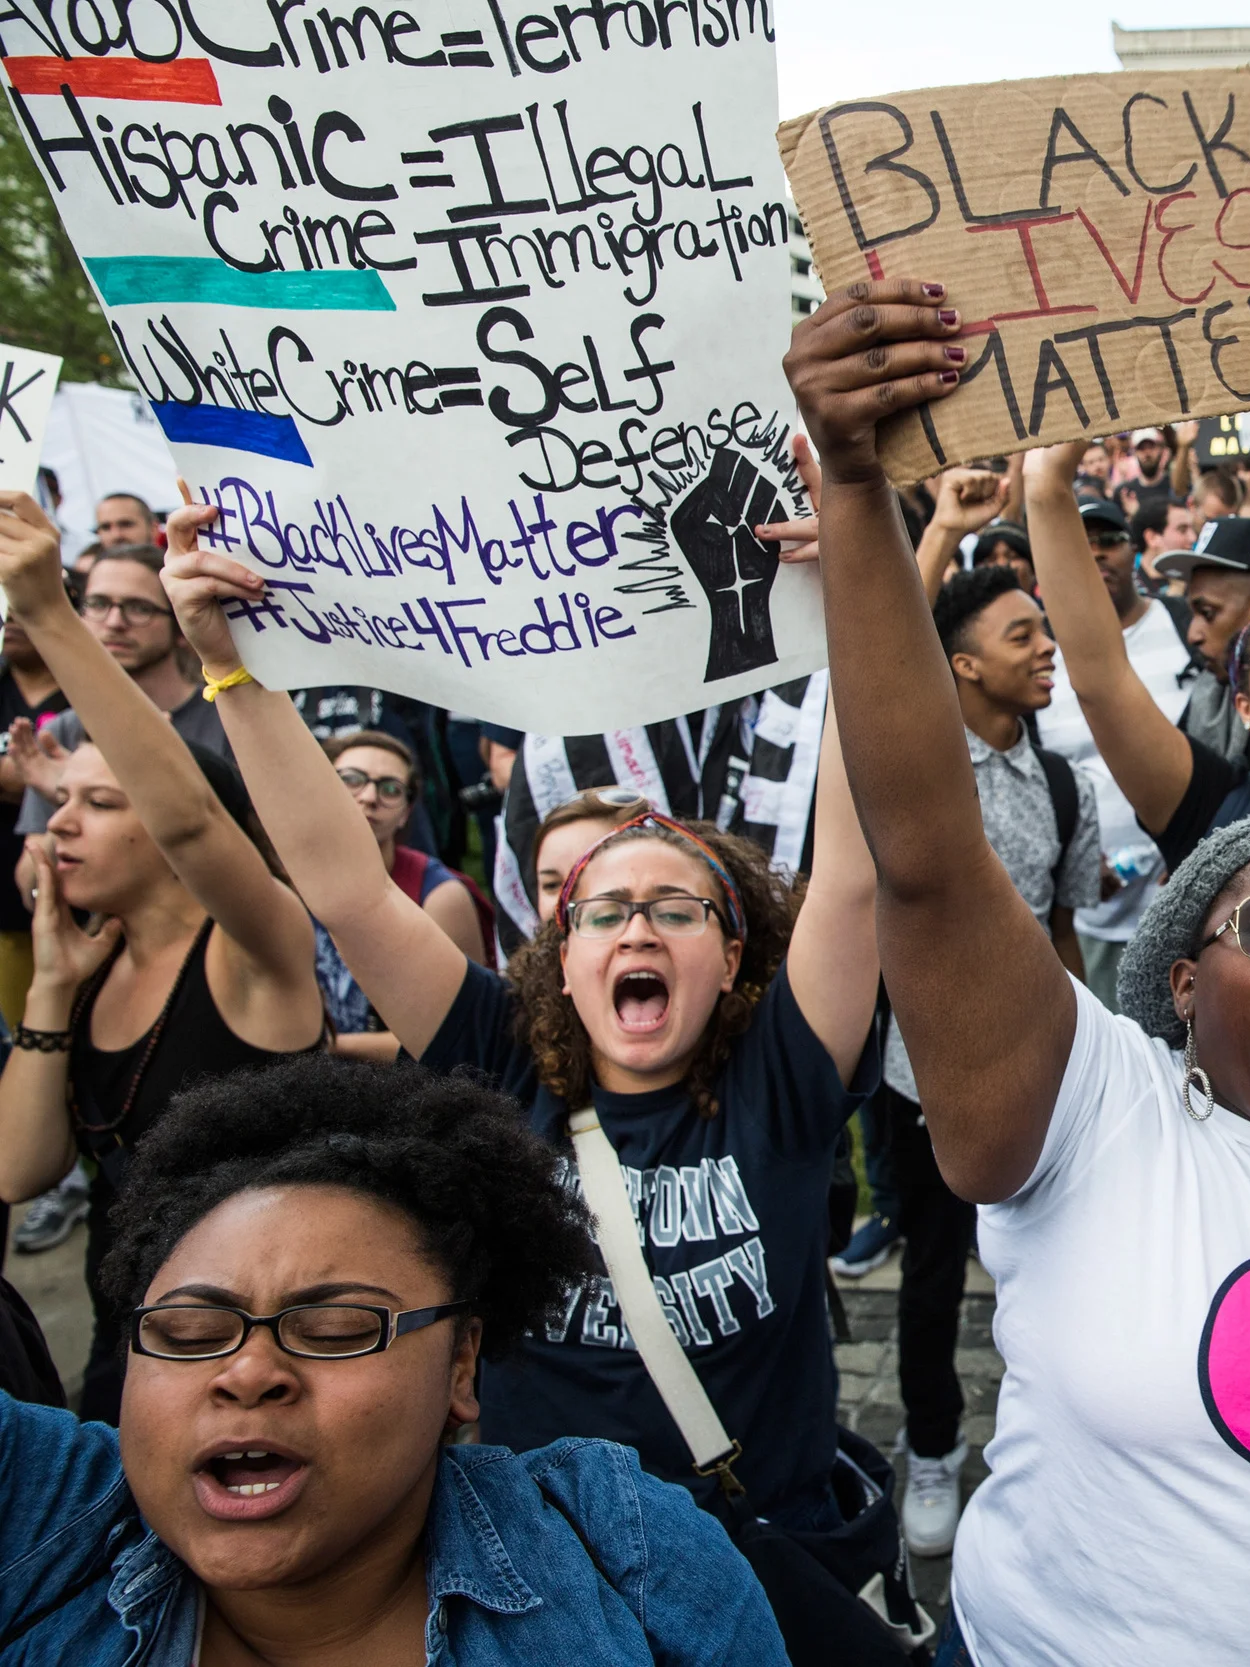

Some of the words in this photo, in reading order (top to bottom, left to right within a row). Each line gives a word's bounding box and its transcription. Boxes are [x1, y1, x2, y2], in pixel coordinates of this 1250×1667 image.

[8, 84, 399, 220] Hispanic
[203, 191, 418, 274] Crime
[413, 198, 788, 306] Immigration
[505, 401, 770, 494] Defense
